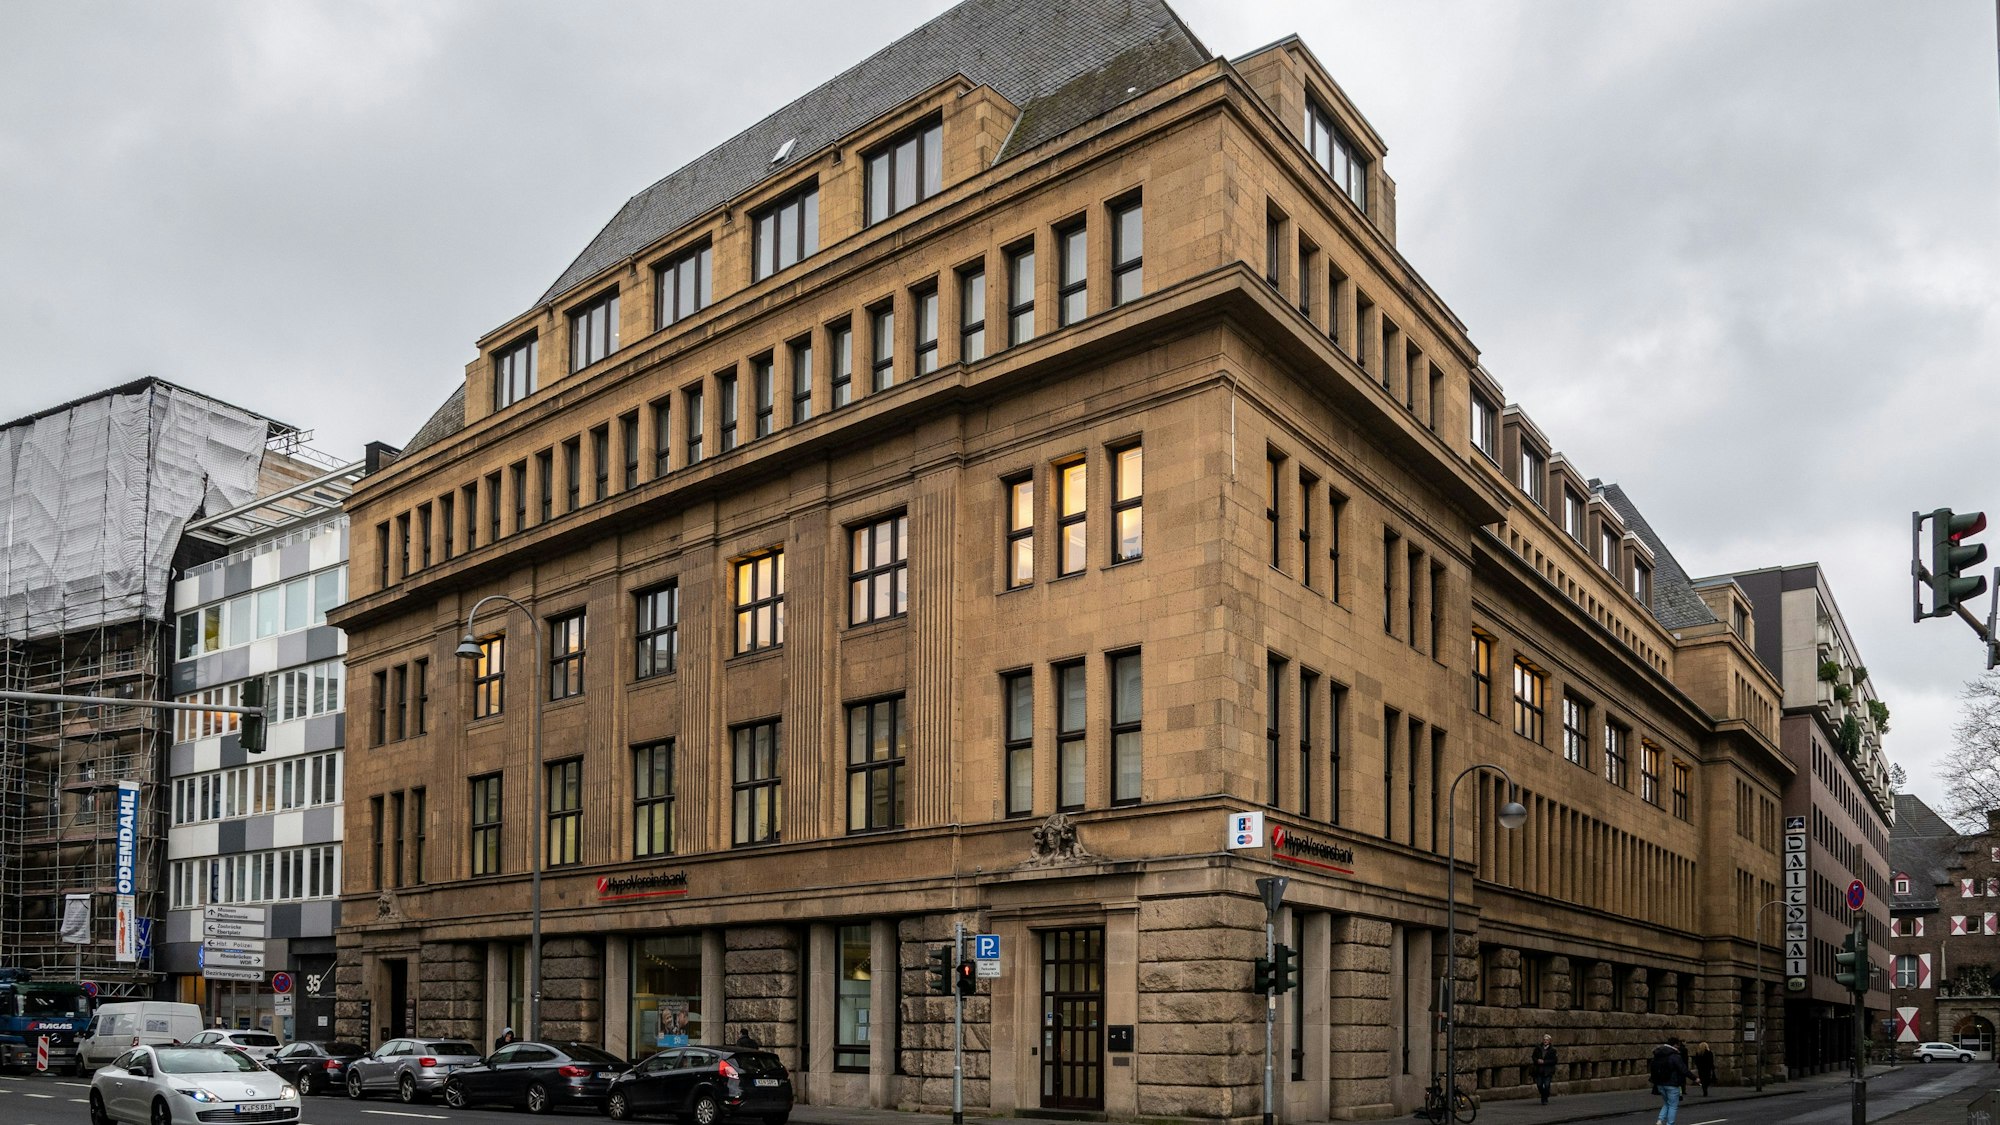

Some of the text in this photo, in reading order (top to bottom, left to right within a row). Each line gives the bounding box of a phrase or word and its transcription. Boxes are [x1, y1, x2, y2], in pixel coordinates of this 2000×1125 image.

[118, 790, 136, 894] ODENDAHL
[1284, 830, 1354, 864] HypoVereinsbank
[608, 870, 687, 895] HypoVereinsbank
[1788, 836, 1804, 973] DAITOAI
[982, 938, 994, 956] P
[206, 970, 252, 979] Bezirksregierung
[306, 974, 321, 992] 35
